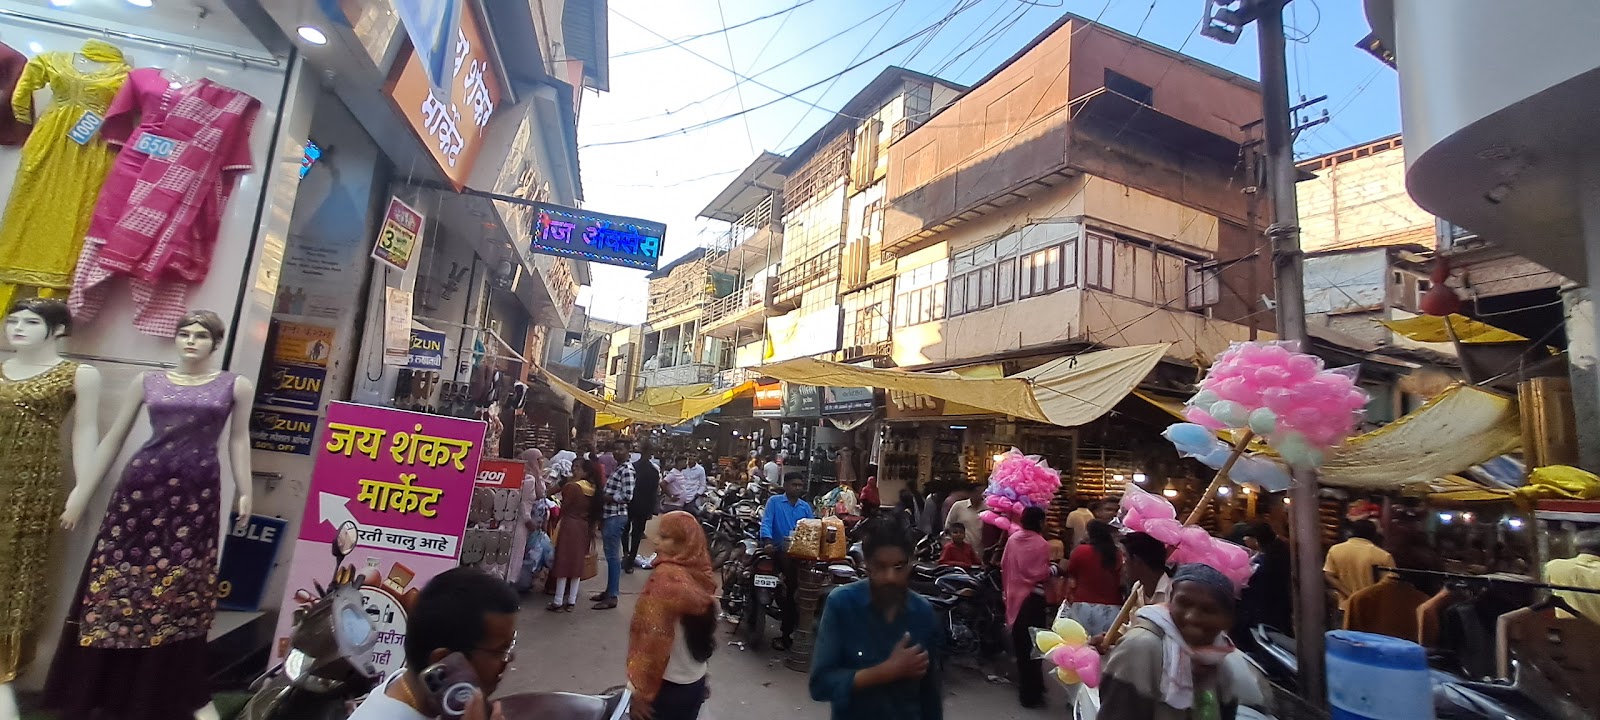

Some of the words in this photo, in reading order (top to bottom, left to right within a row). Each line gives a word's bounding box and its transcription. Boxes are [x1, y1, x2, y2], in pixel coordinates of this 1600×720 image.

[72, 114, 100, 140] 1000
[421, 87, 464, 168] मार्केट
[139, 136, 171, 155] 650
[326, 422, 386, 460] जय
[389, 423, 473, 471] शंकर
[357, 473, 443, 517] मार्केट
[357, 528, 382, 542] रती
[386, 533, 417, 550] चालु
[419, 536, 449, 552] आहे
